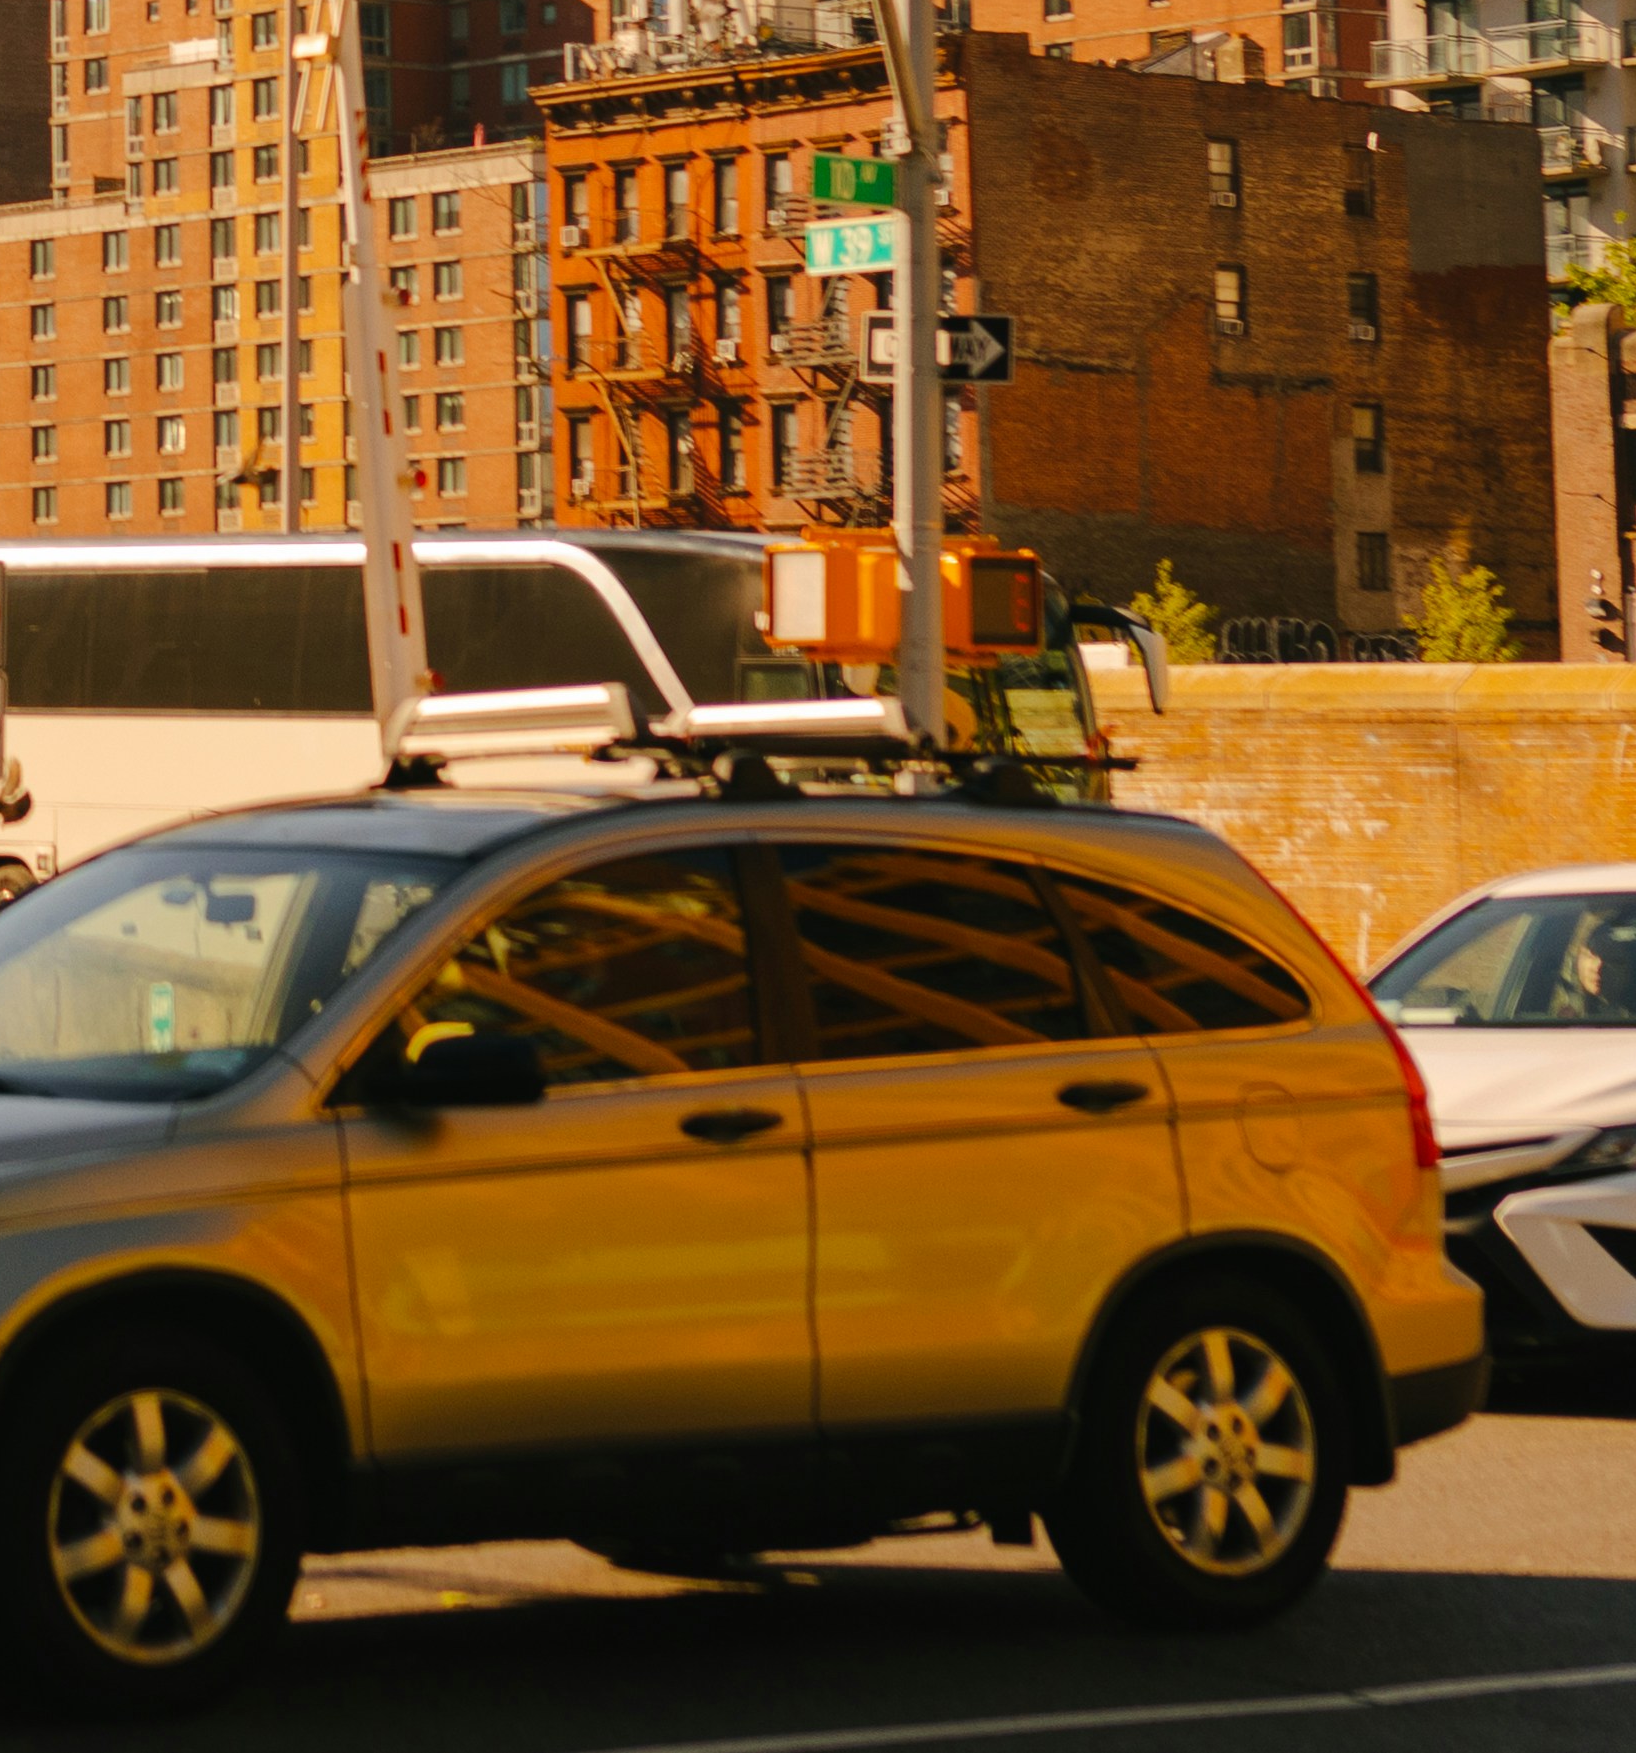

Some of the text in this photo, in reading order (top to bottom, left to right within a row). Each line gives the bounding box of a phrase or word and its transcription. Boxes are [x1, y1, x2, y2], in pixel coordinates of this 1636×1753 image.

[830, 159, 856, 199] 10
[811, 229, 835, 266] W
[839, 225, 873, 265] 39
